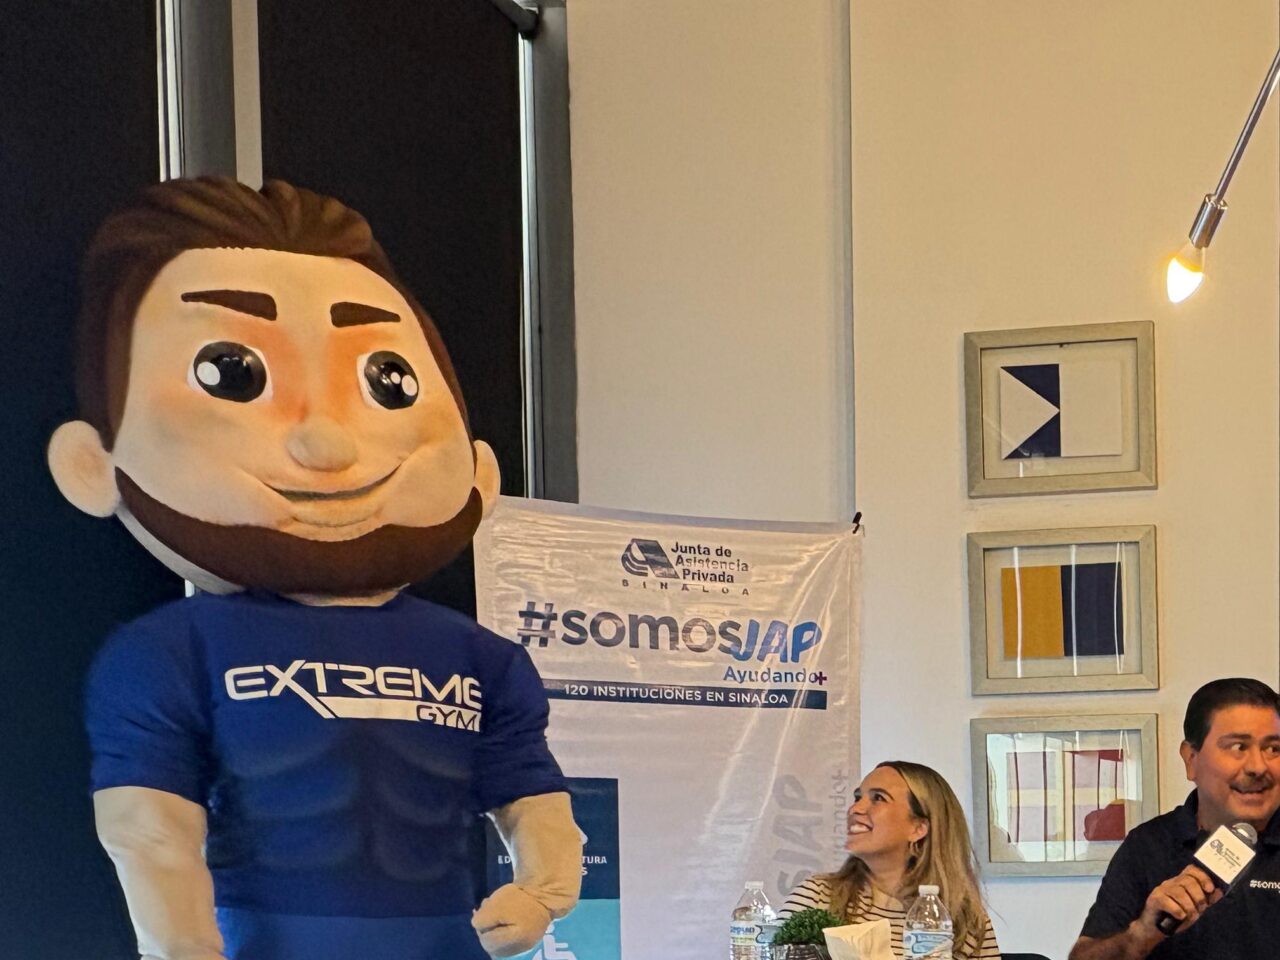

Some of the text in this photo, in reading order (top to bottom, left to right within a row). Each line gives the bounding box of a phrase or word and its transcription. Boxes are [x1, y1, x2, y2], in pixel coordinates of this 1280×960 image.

[671, 542, 732, 557] Junta de
[675, 555, 749, 572] Asistencia
[682, 569, 734, 583] Privada
[516, 601, 823, 663] #somosJAP
[224, 659, 482, 719] EXTREME
[564, 684, 588, 696] 120
[706, 691, 724, 702] EN
[728, 692, 789, 705] SINALOA
[416, 704, 479, 732] GYM
[581, 856, 607, 864] TURA
